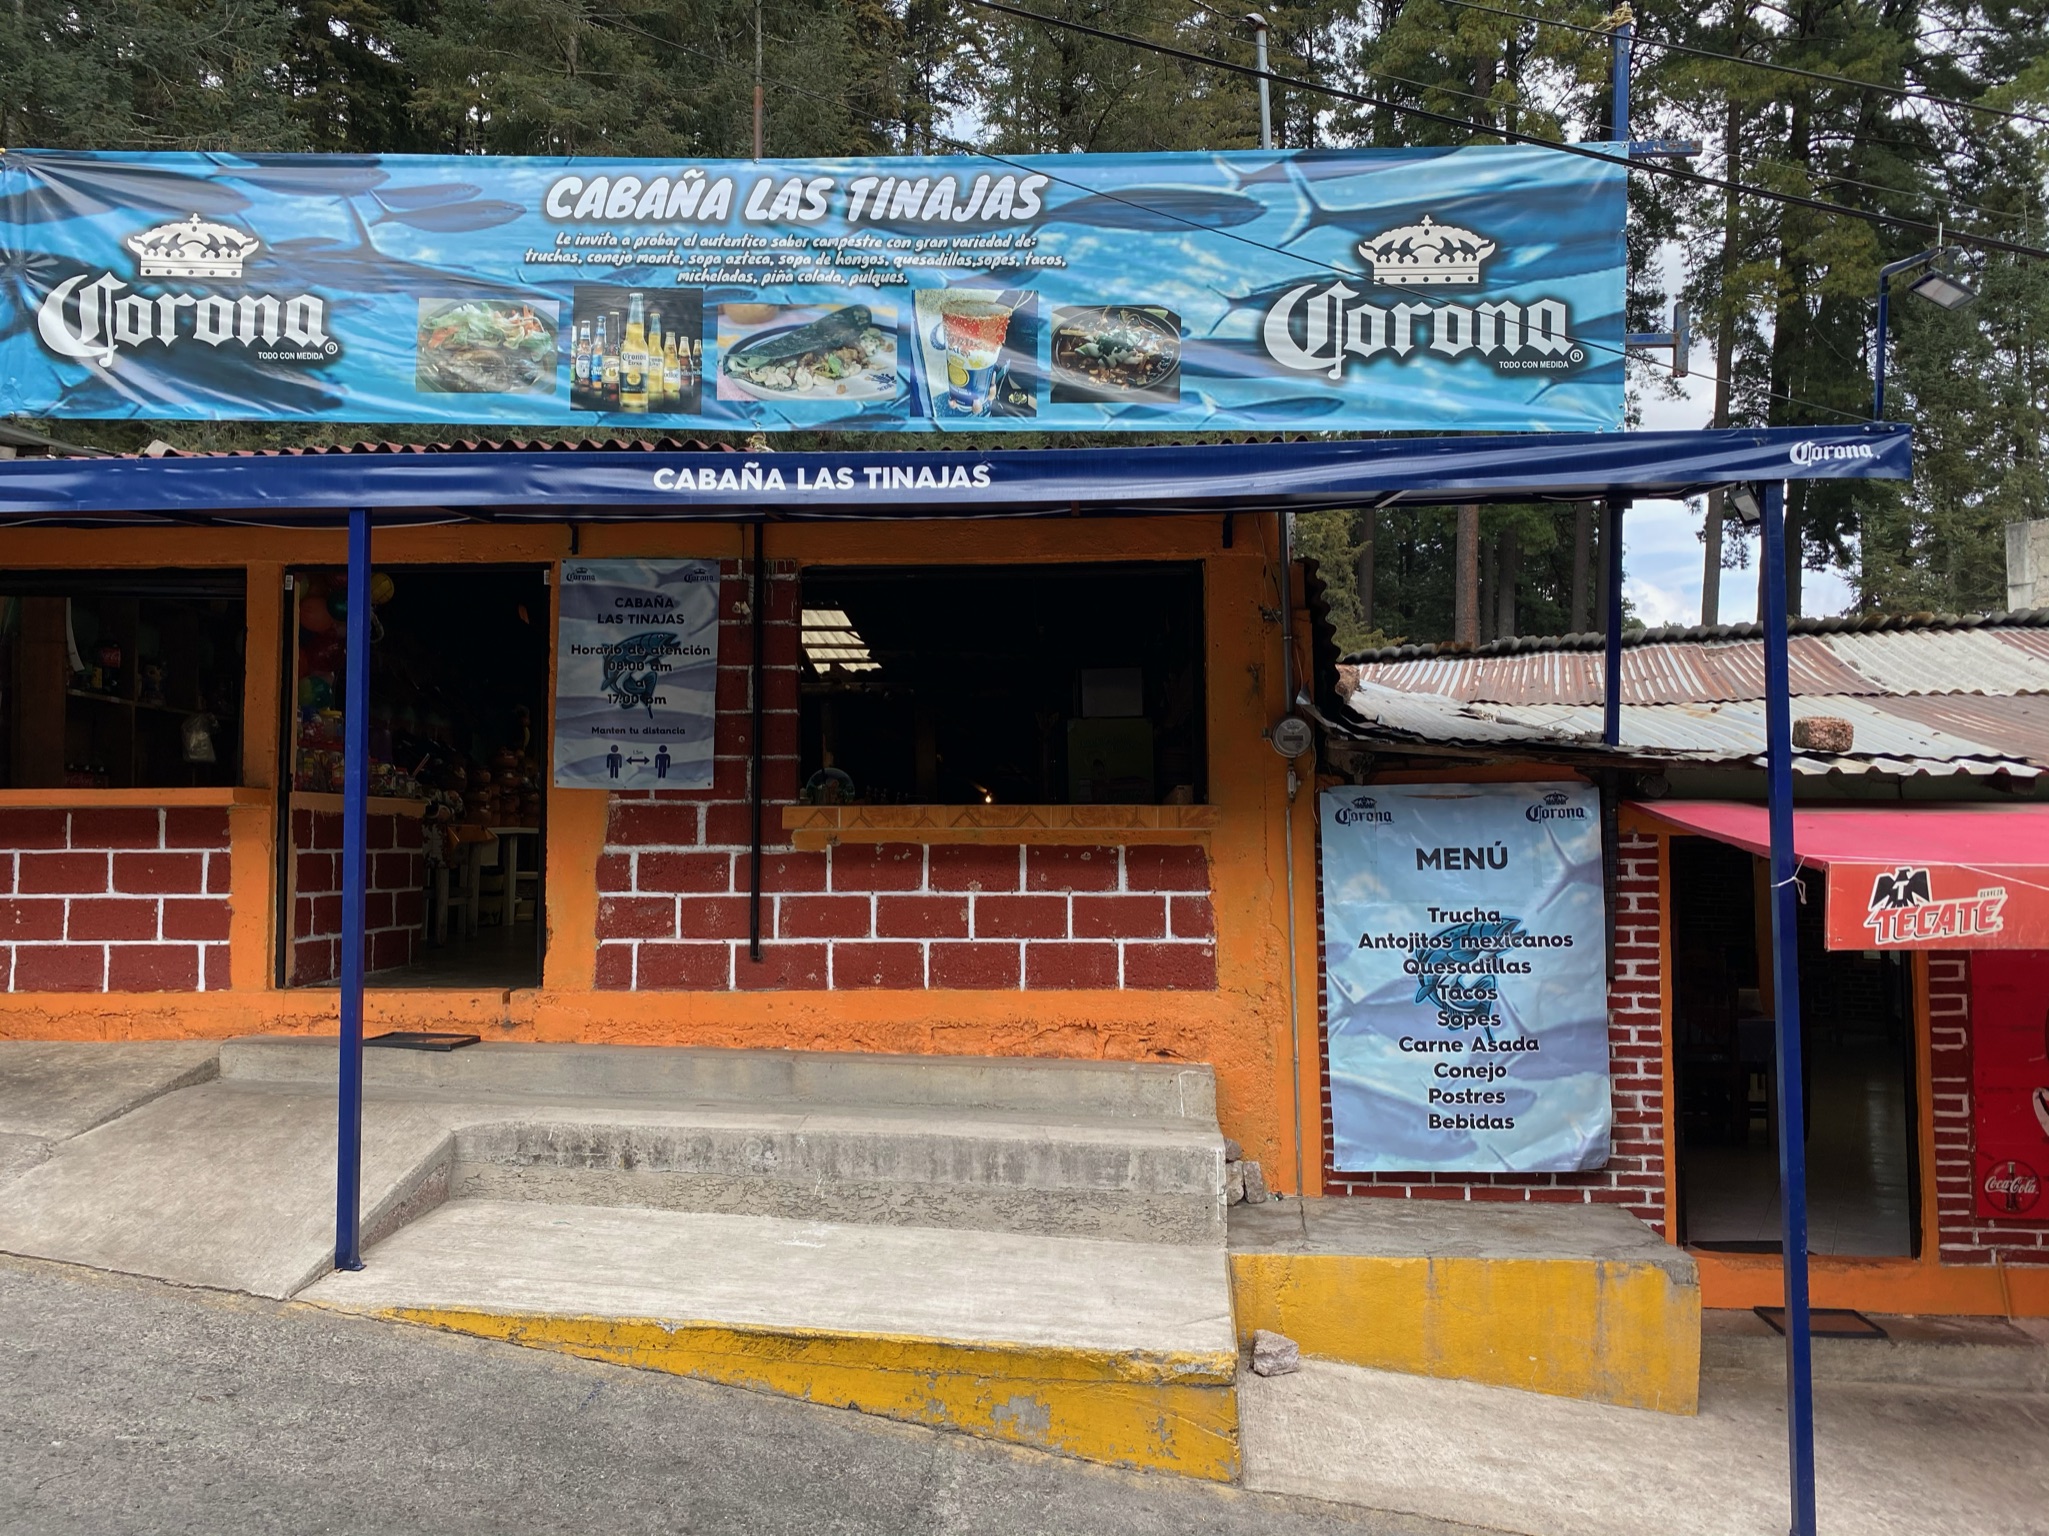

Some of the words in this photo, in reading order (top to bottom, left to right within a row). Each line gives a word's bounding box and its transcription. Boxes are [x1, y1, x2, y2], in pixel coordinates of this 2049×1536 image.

[546, 170, 733, 220] CABAÑA
[744, 177, 835, 221] LAS
[848, 175, 1049, 222] TINAJAS
[555, 232, 571, 246] Le
[574, 231, 618, 246] invita
[621, 237, 630, 246] a
[633, 233, 680, 249] probar
[683, 233, 698, 247] el
[700, 233, 767, 247] autentico
[770, 234, 809, 248] sabor
[812, 236, 883, 251] campestre
[886, 238, 911, 248] con
[915, 238, 948, 251] gran
[952, 234, 1011, 249] variedad
[1015, 234, 1037, 249] de:
[525, 248, 583, 265] truchas,
[586, 250, 633, 267] conejo
[636, 249, 685, 266] monte,
[688, 254, 722, 269] sopa
[725, 250, 775, 267] azteca,
[778, 254, 811, 269] sopa
[815, 252, 832, 266] de
[835, 251, 890, 269] hongos,
[1024, 251, 1067, 268] tacos,
[676, 268, 758, 285] micheladas,
[761, 269, 793, 286] piña
[797, 269, 845, 285] colada,
[848, 269, 908, 287] pulques.
[38, 272, 329, 367] Corona
[1264, 280, 1574, 380] Corona
[258, 352, 278, 360] TODO
[279, 352, 295, 360] CON
[297, 352, 324, 360] MEDIDA
[1499, 361, 1520, 369] TODO
[1521, 361, 1538, 369] CON
[1540, 360, 1569, 368] MEDIDA
[1789, 440, 1874, 467] Corona
[653, 461, 786, 490] CABAÑA
[797, 467, 855, 490] LAS
[864, 465, 991, 489] TINAJAS
[566, 572, 596, 583] Corona
[684, 573, 715, 583] Corona
[615, 594, 675, 609] CABAÑA
[597, 614, 624, 624] LAS
[627, 613, 685, 625] TINAJAS
[571, 644, 623, 656] Horario
[627, 644, 645, 656] de
[650, 643, 711, 656] atención
[608, 661, 645, 672] 08:00
[650, 663, 673, 672] am
[635, 679, 645, 688] a
[607, 694, 639, 705] 17:00
[646, 696, 667, 707] pm
[592, 727, 626, 735] Manten
[629, 727, 639, 735] tu
[642, 726, 686, 735] distancia
[1335, 807, 1393, 826] Corona
[1525, 804, 1585, 824] Corona
[1415, 840, 1508, 871] MENÚ
[1427, 907, 1501, 923] Trucha
[1867, 898, 2002, 942] TECATE
[1358, 932, 1452, 953] Antojitos
[1460, 932, 1574, 948] mexicanos
[1403, 958, 1532, 976] Quesadillas
[1437, 984, 1498, 1000] Tacos
[1437, 1010, 1502, 1030] Sopes
[1399, 1036, 1464, 1052] Carne
[1471, 1036, 1540, 1052] Asada
[1434, 1062, 1507, 1083] Conejo
[1428, 1088, 1506, 1104] Postres
[1428, 1113, 1515, 1130] Bebidas
